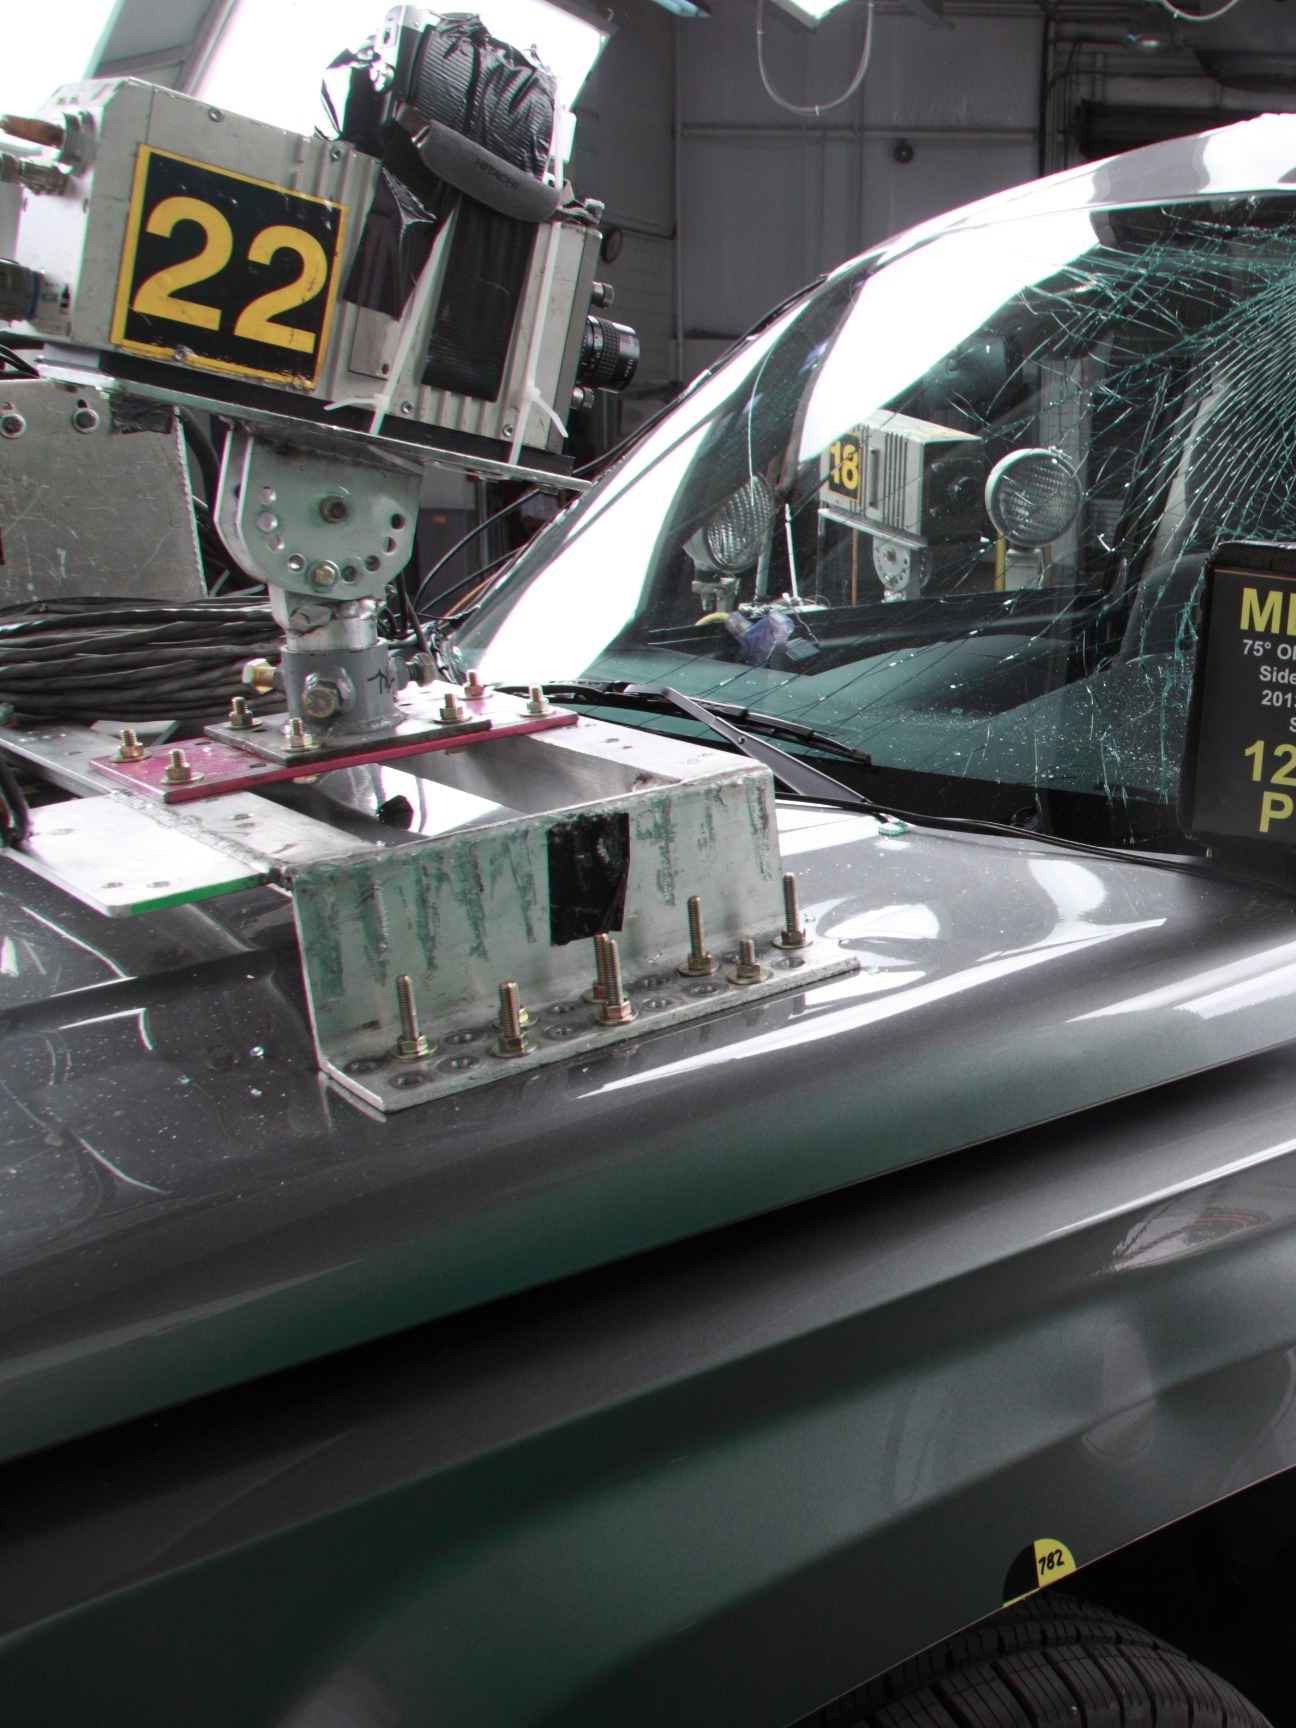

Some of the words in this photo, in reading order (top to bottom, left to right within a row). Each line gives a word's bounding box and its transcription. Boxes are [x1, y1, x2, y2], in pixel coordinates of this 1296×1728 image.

[133, 195, 328, 354] 22
[830, 440, 859, 490] 18
[1242, 639, 1272, 657] 75°
[1038, 1548, 1065, 1576] 782
